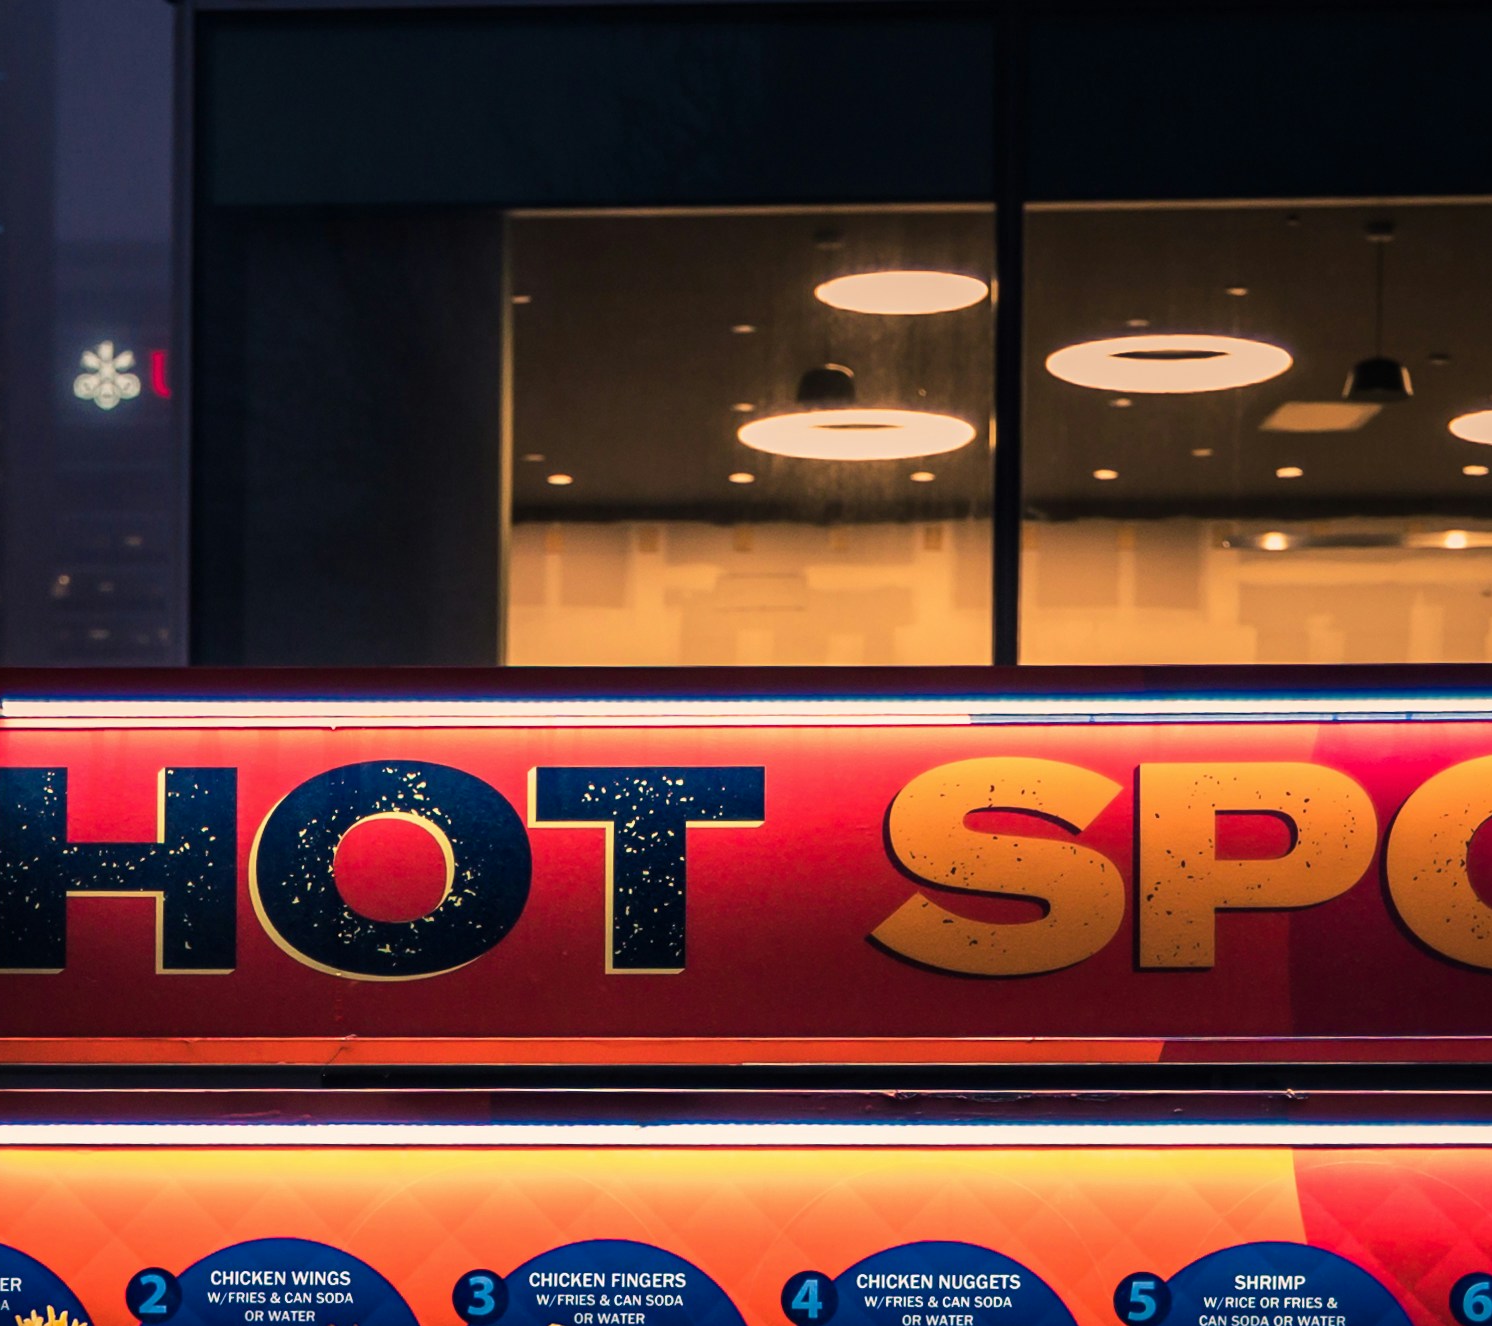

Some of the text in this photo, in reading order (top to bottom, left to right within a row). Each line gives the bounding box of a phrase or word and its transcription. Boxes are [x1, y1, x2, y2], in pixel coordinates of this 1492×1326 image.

[210, 1269, 351, 1286] CHICKEN WINGS
[528, 1271, 687, 1289] CHICKEN FINGERS
[856, 1273, 1021, 1290] CHICKEN NUGGETS
[1234, 1274, 1306, 1291] SHRIMP
[137, 1274, 168, 1314] 2
[207, 1291, 354, 1305] W/FRIES & CAN SODA
[466, 1277, 497, 1316] 3
[536, 1293, 684, 1307] W/FRIES & CAN SODA
[790, 1279, 824, 1319] 4
[1127, 1281, 1158, 1322] 5
[864, 1295, 1013, 1309] W/FRIES & CAN SODA
[1203, 1296, 1338, 1310] W/RICE OR FRIES &
[244, 1309, 316, 1322] OR WATER
[573, 1312, 646, 1325] OR WATER
[901, 1314, 974, 1326] OR WATER
[1198, 1314, 1227, 1326] CAN
[1231, 1315, 1270, 1326] SODA
[1296, 1315, 1346, 1326] WATER
